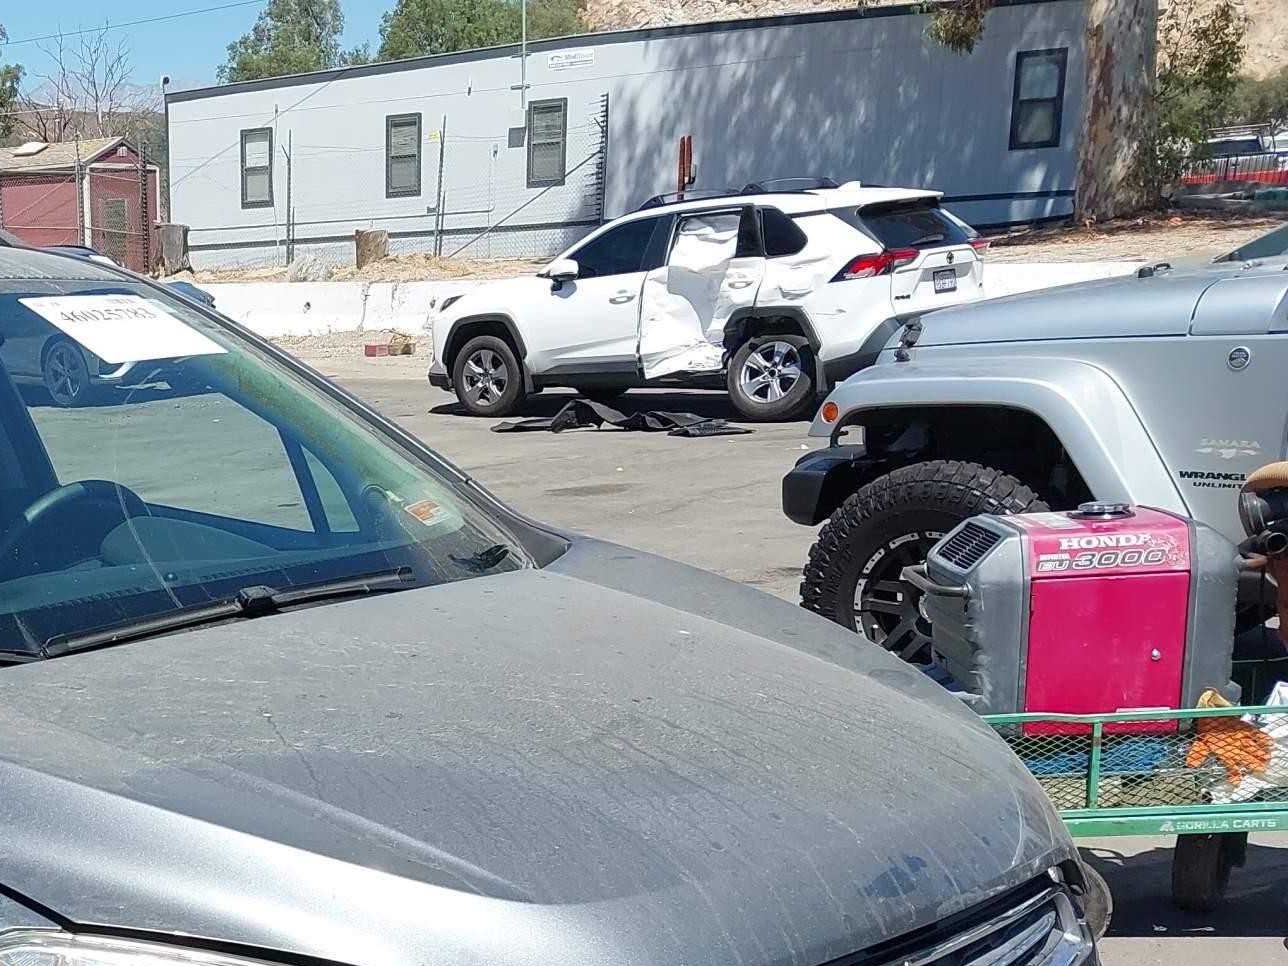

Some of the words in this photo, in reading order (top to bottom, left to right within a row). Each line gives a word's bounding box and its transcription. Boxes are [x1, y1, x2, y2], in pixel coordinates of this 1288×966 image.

[1179, 470, 1247, 481] WRANGL
[1193, 481, 1244, 490] UNLIMIT
[1072, 548, 1168, 570] 3000
[1233, 819, 1277, 829] CARTS
